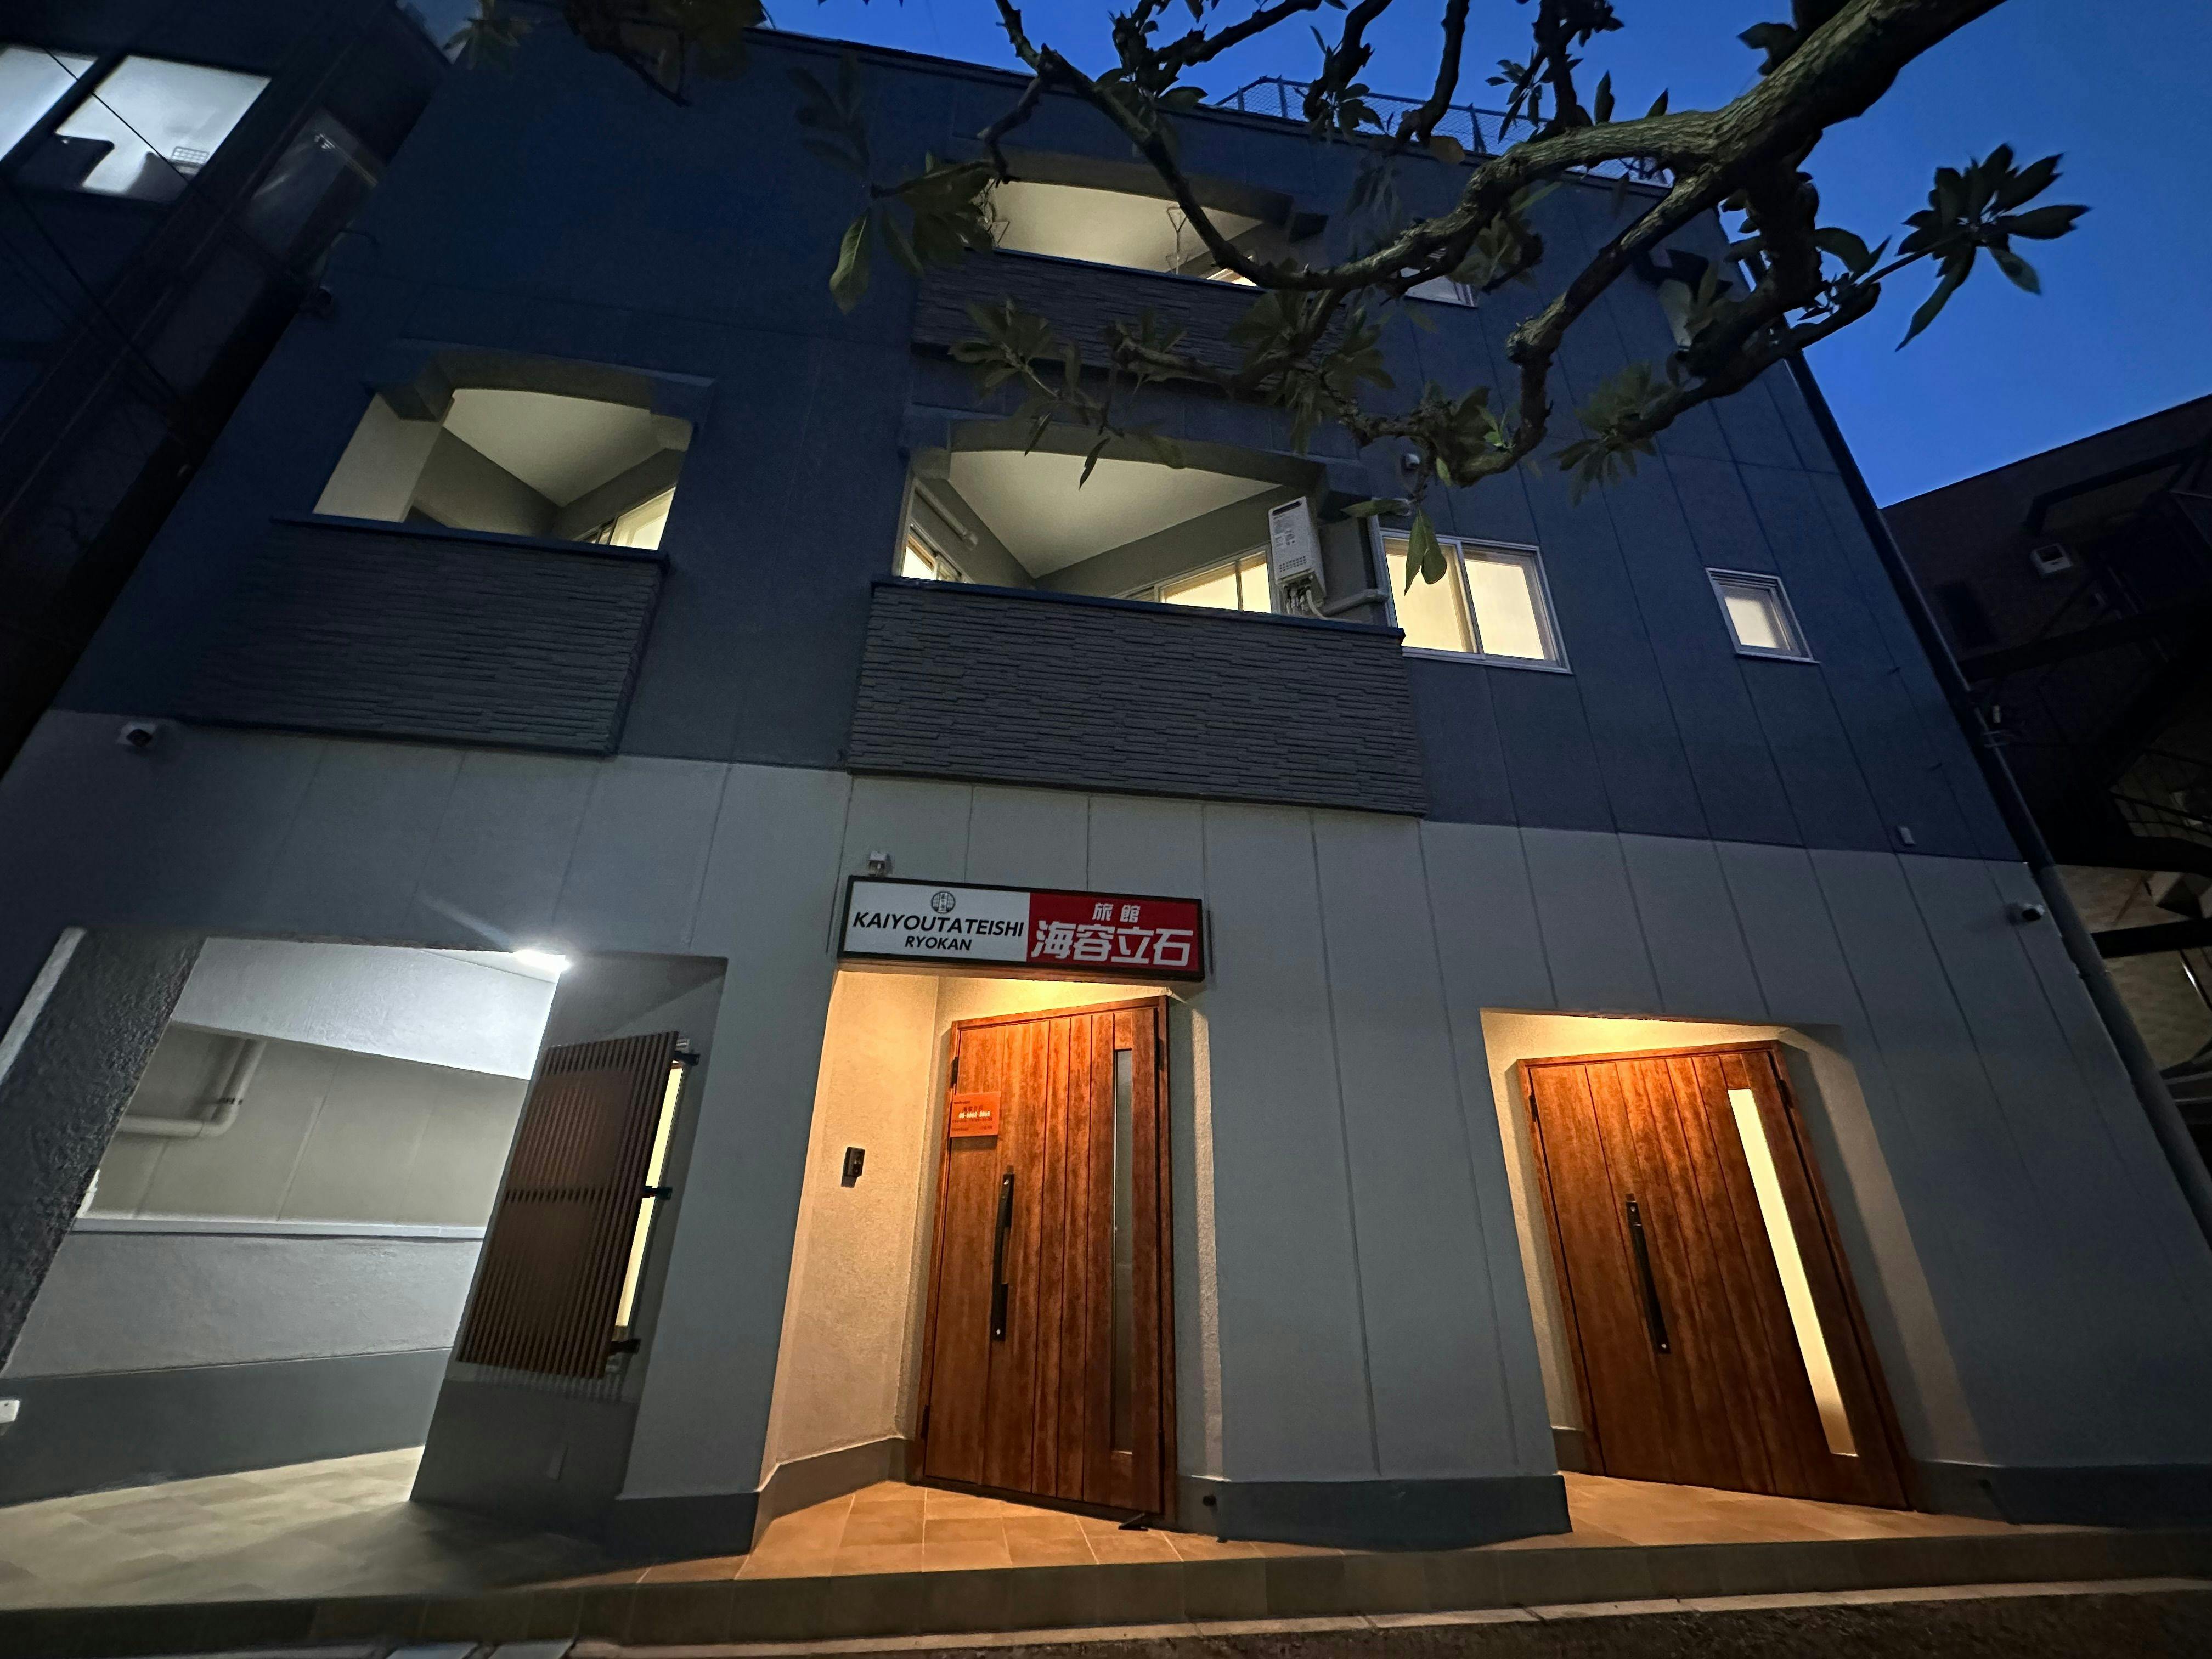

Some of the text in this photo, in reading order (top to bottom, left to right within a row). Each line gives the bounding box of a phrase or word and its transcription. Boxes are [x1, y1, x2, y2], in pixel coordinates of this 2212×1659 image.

[1092, 902, 1141, 923] 旅館
[853, 912, 1024, 937] KAIYOUTATEISHI
[905, 936, 972, 951] RYOKAN
[1031, 920, 1193, 966] 海容立石
